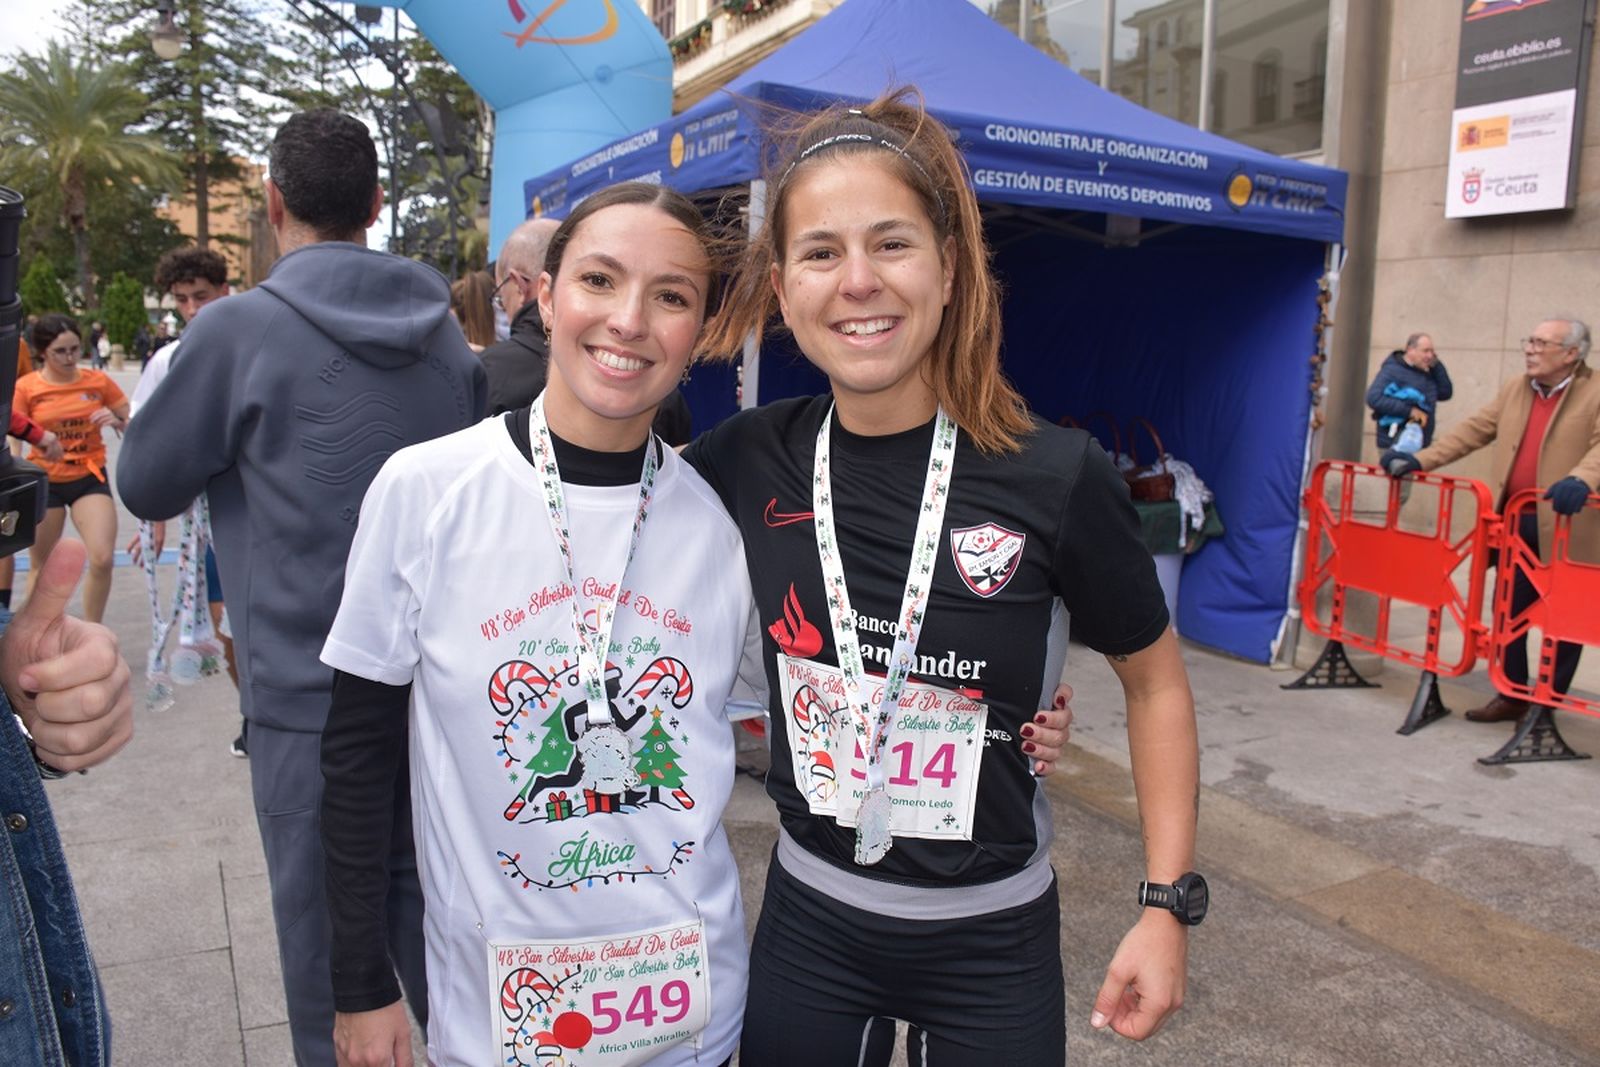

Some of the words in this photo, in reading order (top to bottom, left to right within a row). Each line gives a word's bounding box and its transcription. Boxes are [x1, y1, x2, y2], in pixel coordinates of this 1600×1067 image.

[1473, 37, 1562, 65] ceuta.ebiblio.es
[836, 134, 872, 145] PRO
[985, 123, 1105, 154] CRONOMETRAJE
[1107, 140, 1209, 170] ORGANIZACIÓN
[1098, 160, 1108, 176] Y
[974, 169, 1040, 190] GESTIÓN
[1043, 177, 1063, 193] DE
[1066, 179, 1129, 201] EVENTOS
[1131, 187, 1212, 212] DEPORTIVOS
[1494, 181, 1538, 197] Ceuta
[503, 607, 526, 632] San
[582, 576, 632, 606] Ciudd
[634, 595, 659, 620] De
[663, 608, 694, 635] Ceuta
[544, 638, 569, 655] San
[627, 636, 662, 656] Baby
[858, 641, 988, 681] annder
[918, 691, 942, 712] De
[945, 694, 981, 712] Ceuta
[897, 714, 941, 733] Silvestre
[944, 713, 976, 733] Baby
[889, 796, 926, 808] omero
[928, 799, 954, 809] Ledo
[547, 829, 638, 879] África
[518, 946, 543, 966] San
[547, 945, 596, 967] Silvestre
[600, 937, 643, 963] Ciudad
[645, 934, 666, 955] De
[670, 928, 700, 953] Ceuta
[603, 964, 626, 981] San
[628, 957, 670, 979] Silvestre
[672, 950, 700, 971] Baby
[591, 979, 691, 1036] 549
[629, 1034, 652, 1049] Villa
[653, 1028, 691, 1045] Miralles
